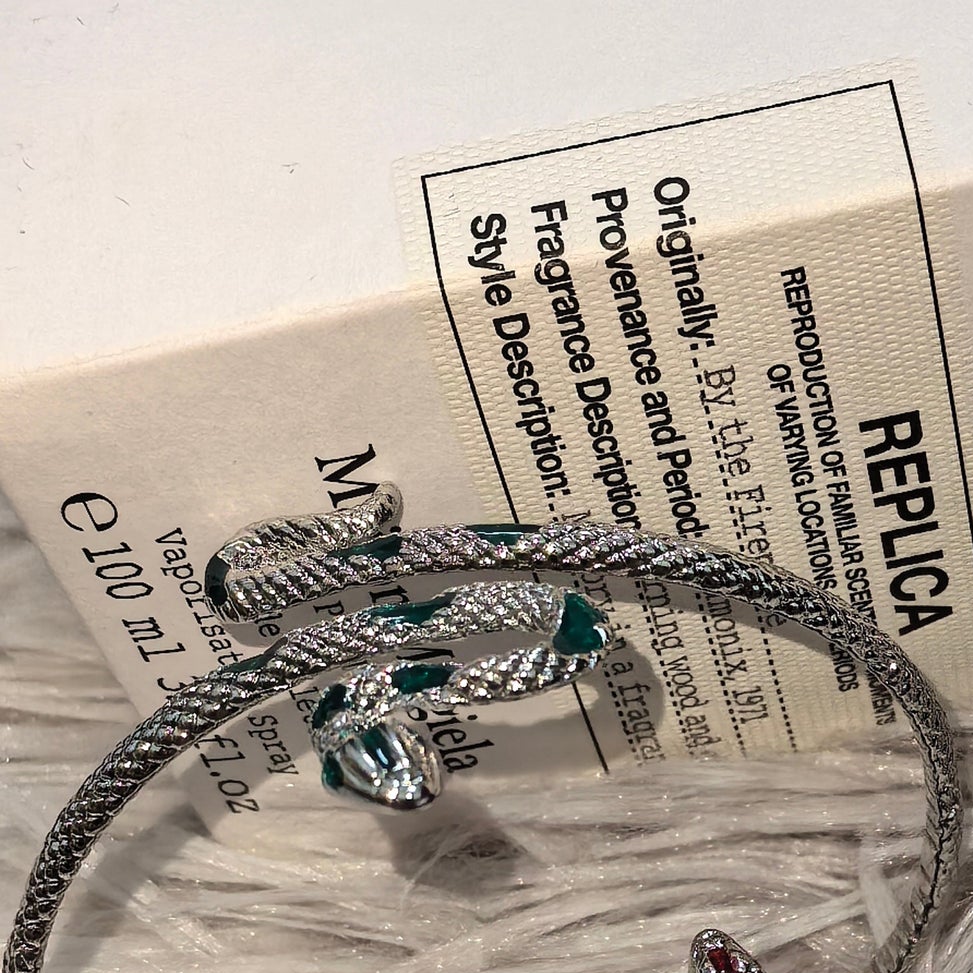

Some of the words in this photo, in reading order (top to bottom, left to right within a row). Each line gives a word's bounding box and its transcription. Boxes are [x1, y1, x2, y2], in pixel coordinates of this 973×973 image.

[653, 176, 718, 350] Originally:
[699, 365, 736, 407] By
[718, 418, 754, 477] the
[767, 364, 796, 394] OF
[780, 266, 840, 448] REPRODUCTION
[467, 213, 516, 307] Style
[492, 312, 571, 498] Description:
[611, 661, 633, 675] a
[530, 200, 595, 374] Fragrance
[664, 655, 709, 711] wood
[591, 187, 661, 386] Provenance
[641, 391, 686, 447] and
[731, 685, 769, 724] 1971
[774, 395, 815, 488] VARYING
[820, 450, 848, 479] OF
[826, 480, 864, 566] FAMILIAR
[858, 410, 953, 637] REPLICA
[795, 489, 837, 591] LOCATIONS
[81, 542, 154, 599] 100
[121, 617, 186, 662] ml
[194, 734, 260, 814] fl.oz
[247, 715, 299, 775] Spray
